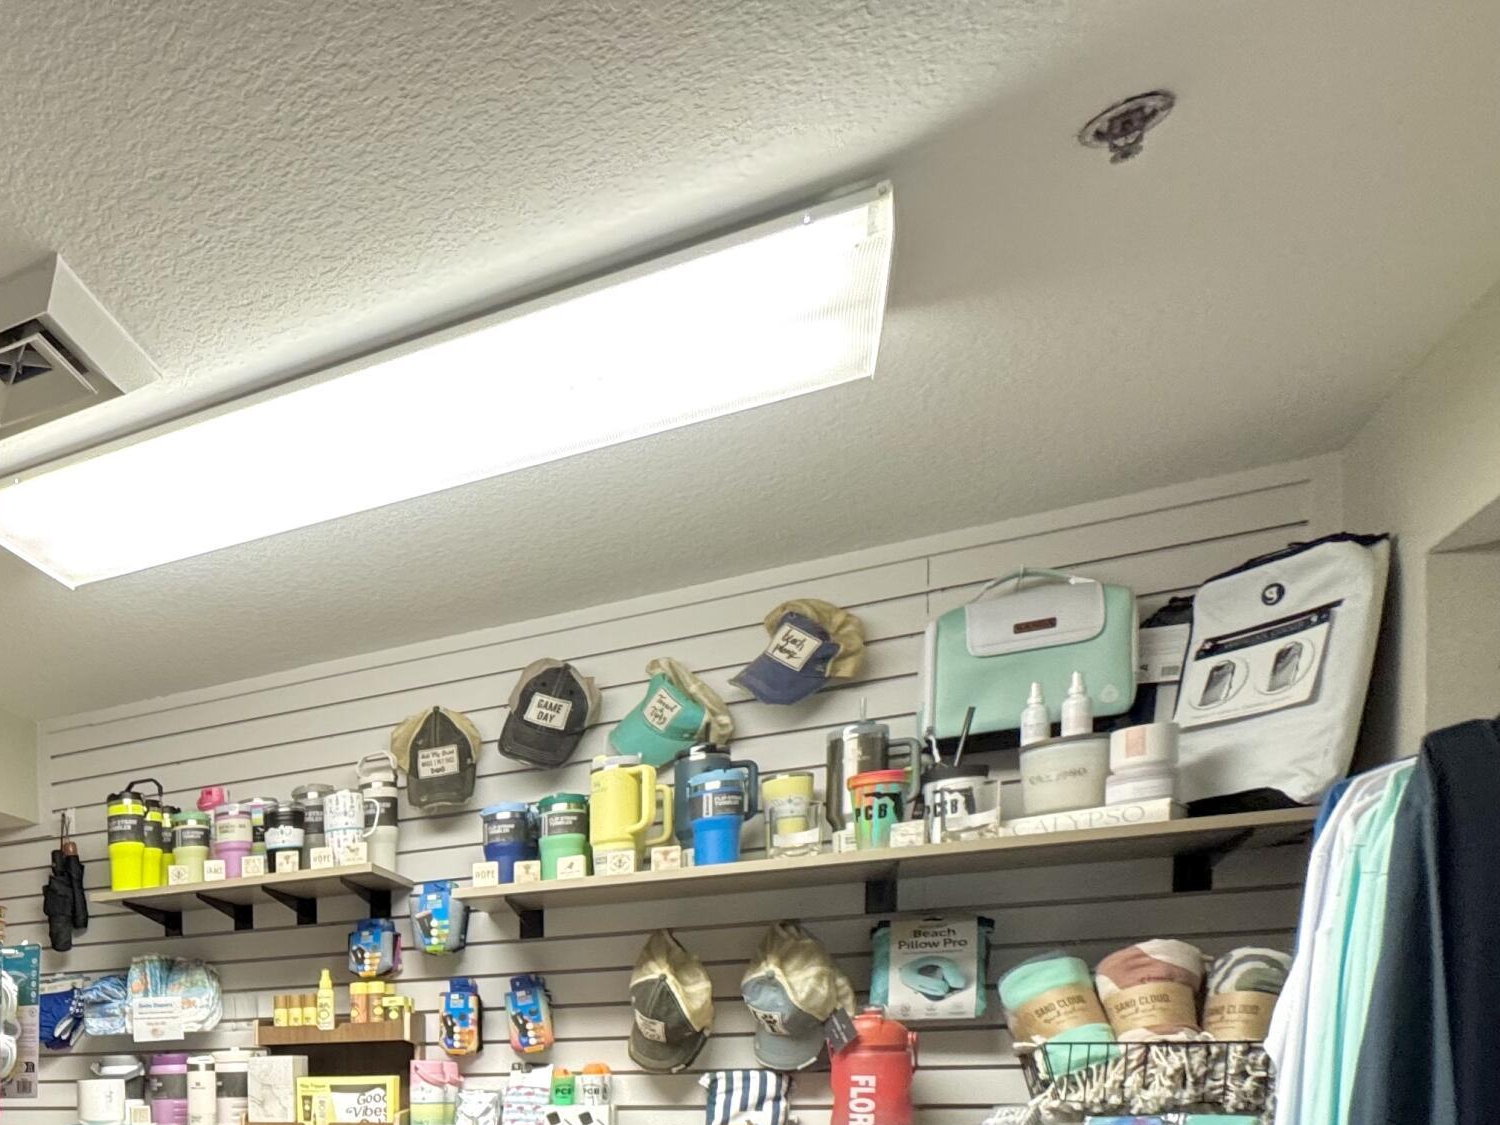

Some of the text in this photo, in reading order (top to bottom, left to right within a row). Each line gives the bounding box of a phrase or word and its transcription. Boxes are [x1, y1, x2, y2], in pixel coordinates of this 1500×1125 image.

[537, 699, 563, 714] GAME
[536, 711, 556, 723] DAY
[912, 928, 957, 938] Beach
[898, 937, 969, 950] Pillow Pro
[1114, 999, 1137, 1013] SAND
